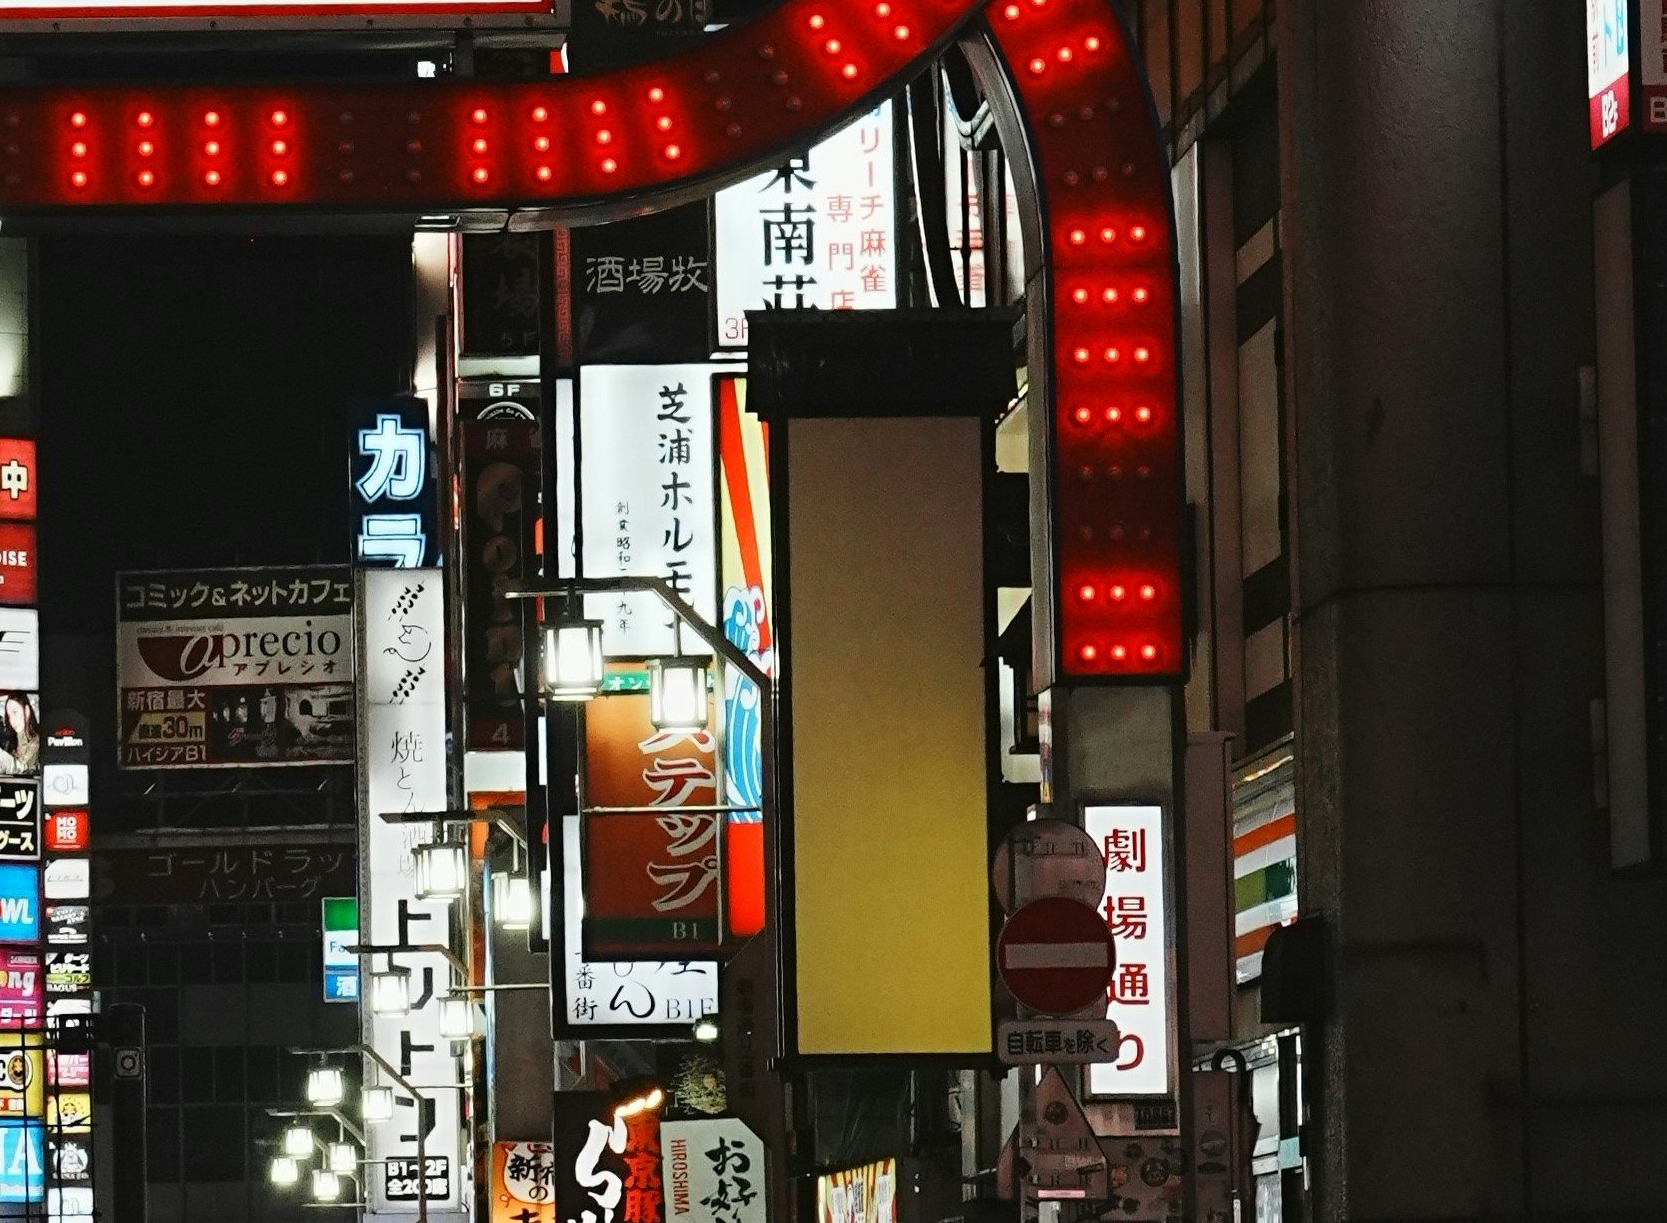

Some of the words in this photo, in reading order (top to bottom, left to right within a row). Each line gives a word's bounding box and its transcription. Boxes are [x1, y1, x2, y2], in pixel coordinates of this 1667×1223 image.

[826, 194, 856, 310] 専門店
[858, 127, 888, 294] リーチ麻雀
[488, 383, 521, 398] 6F
[656, 381, 695, 629] 芝浦ホルモ
[126, 578, 351, 609] コミック&ネットカフェ
[616, 500, 633, 636] 創業昭和九年
[181, 620, 341, 676] aprecio
[1103, 827, 1151, 1071] 劇場通り
[1006, 1030, 1108, 1056] 自転車を除く
[670, 1138, 691, 1216] HIROSHIMA
